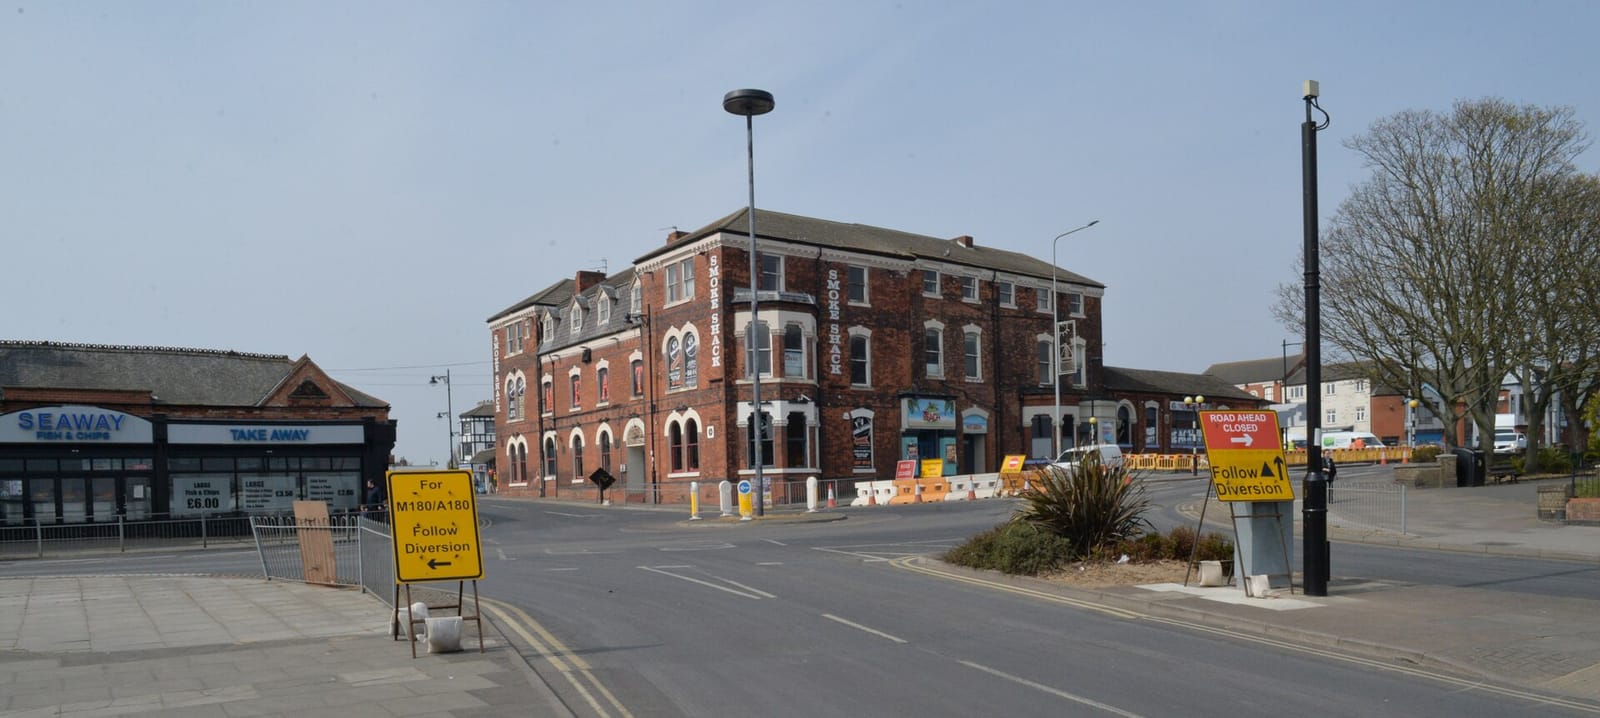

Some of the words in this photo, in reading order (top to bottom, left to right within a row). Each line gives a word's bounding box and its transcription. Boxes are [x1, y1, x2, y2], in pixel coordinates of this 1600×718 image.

[709, 255, 720, 310] SMOKE
[828, 269, 840, 321] SMOKE
[711, 313, 721, 368] SHACK
[829, 323, 842, 376] SHACK
[18, 412, 125, 431] SEAWAY
[1210, 413, 1236, 423] ROAD
[1237, 413, 1267, 423] AHEAD
[230, 428, 267, 441] TAKE
[270, 428, 310, 441] AWAY
[1223, 423, 1258, 433] CLOSED
[36, 431, 62, 440] FISH
[65, 431, 73, 440] &
[76, 431, 111, 440] CHIPS
[1212, 465, 1258, 480] Follow
[420, 479, 443, 490] For
[1215, 481, 1283, 496] Diversion
[187, 497, 219, 509] £6.00
[396, 499, 470, 512] M180/A180
[413, 526, 458, 536] Follow
[405, 542, 470, 554] Diversion
